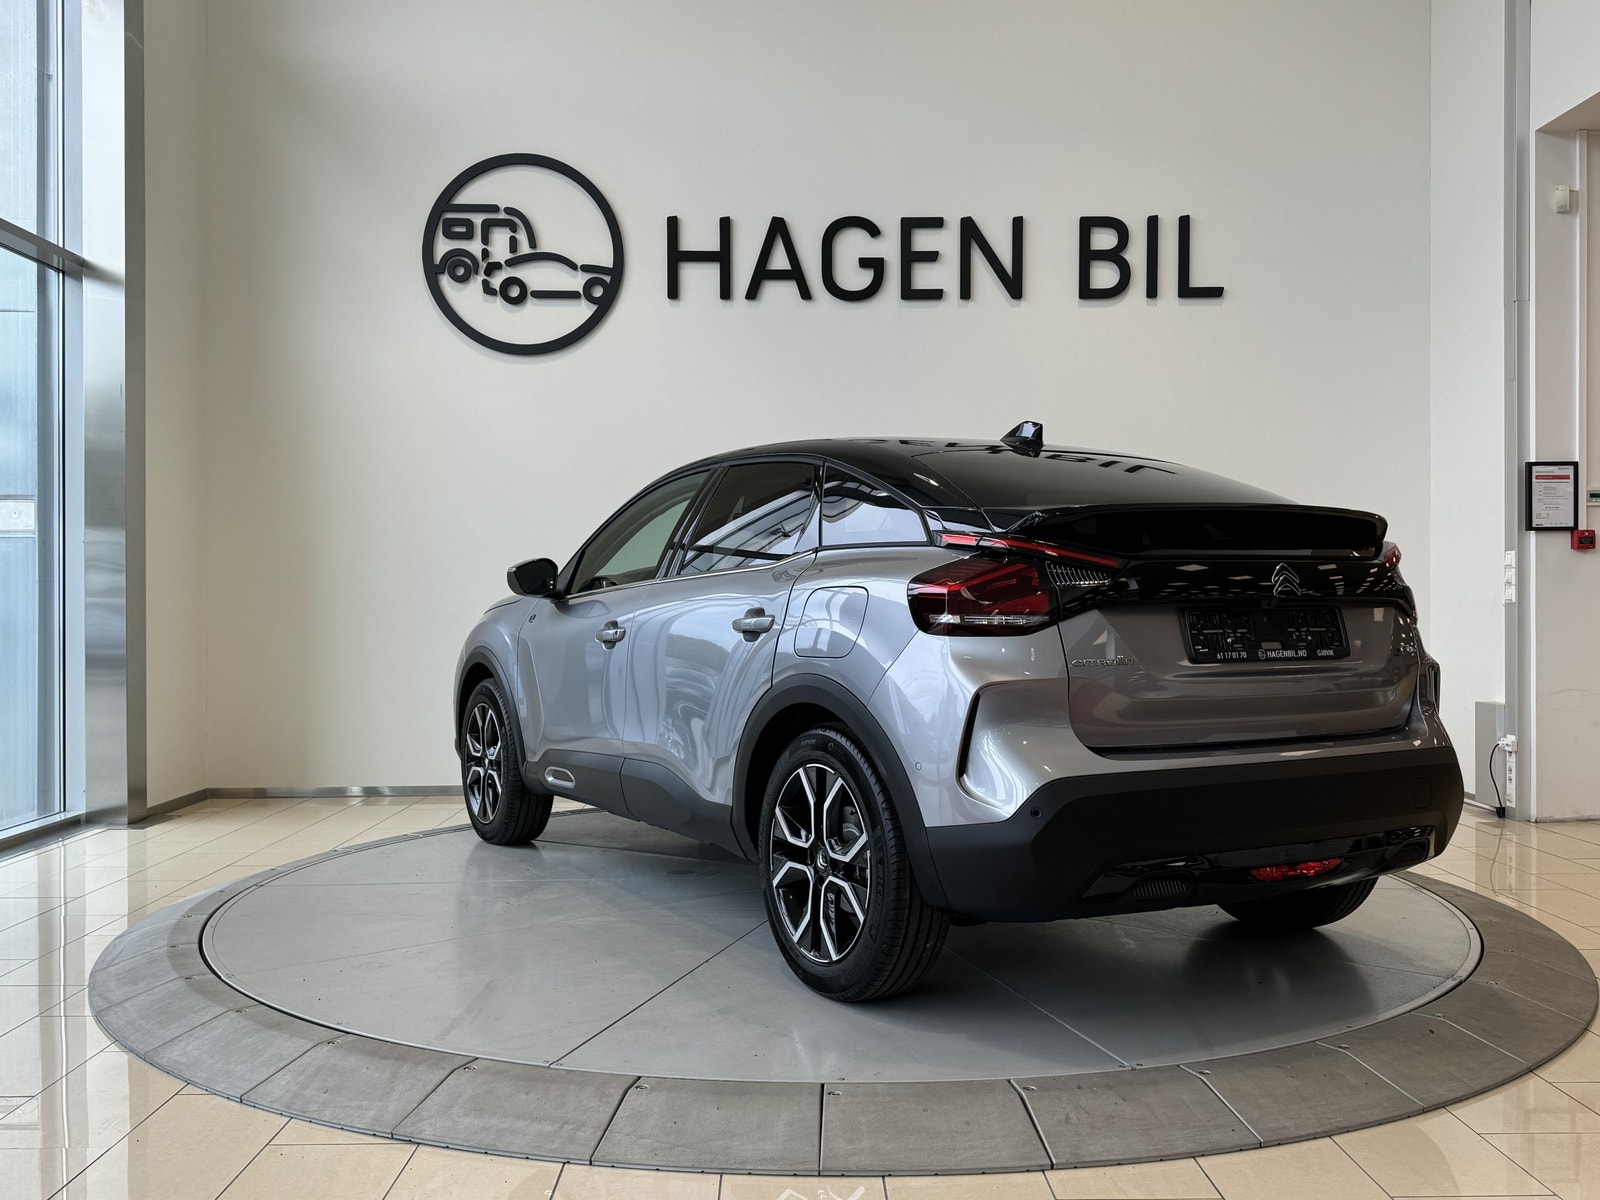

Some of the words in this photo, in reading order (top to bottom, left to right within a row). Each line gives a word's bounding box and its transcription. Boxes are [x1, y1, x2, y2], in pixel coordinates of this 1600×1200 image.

[667, 215, 1024, 302] HAGEN
[1078, 214, 1225, 301] BIL
[1267, 649, 1307, 658] HAGENBIL.NO
